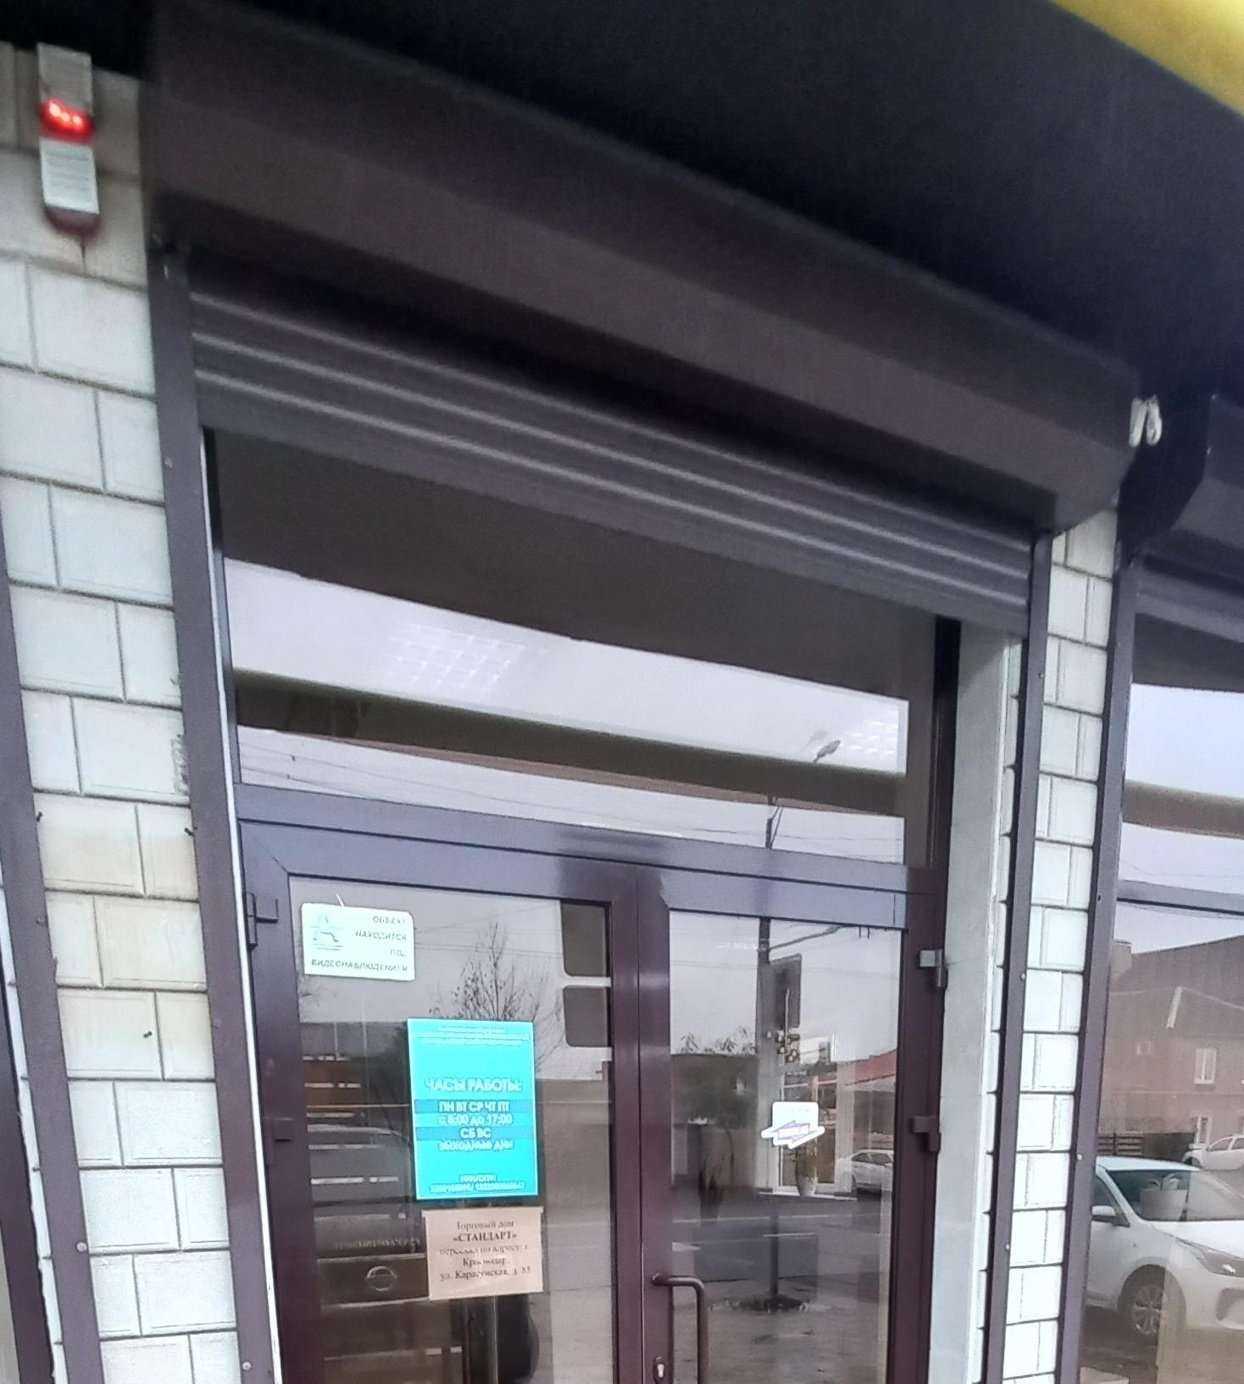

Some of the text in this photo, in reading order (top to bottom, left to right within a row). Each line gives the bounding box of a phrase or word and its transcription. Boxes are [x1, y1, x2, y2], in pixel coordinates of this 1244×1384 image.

[425, 1078, 465, 1091] ЧАСЫ
[439, 1101, 454, 1112] ПН
[468, 1101, 484, 1112] СР
[460, 1127, 476, 1139] СБ
